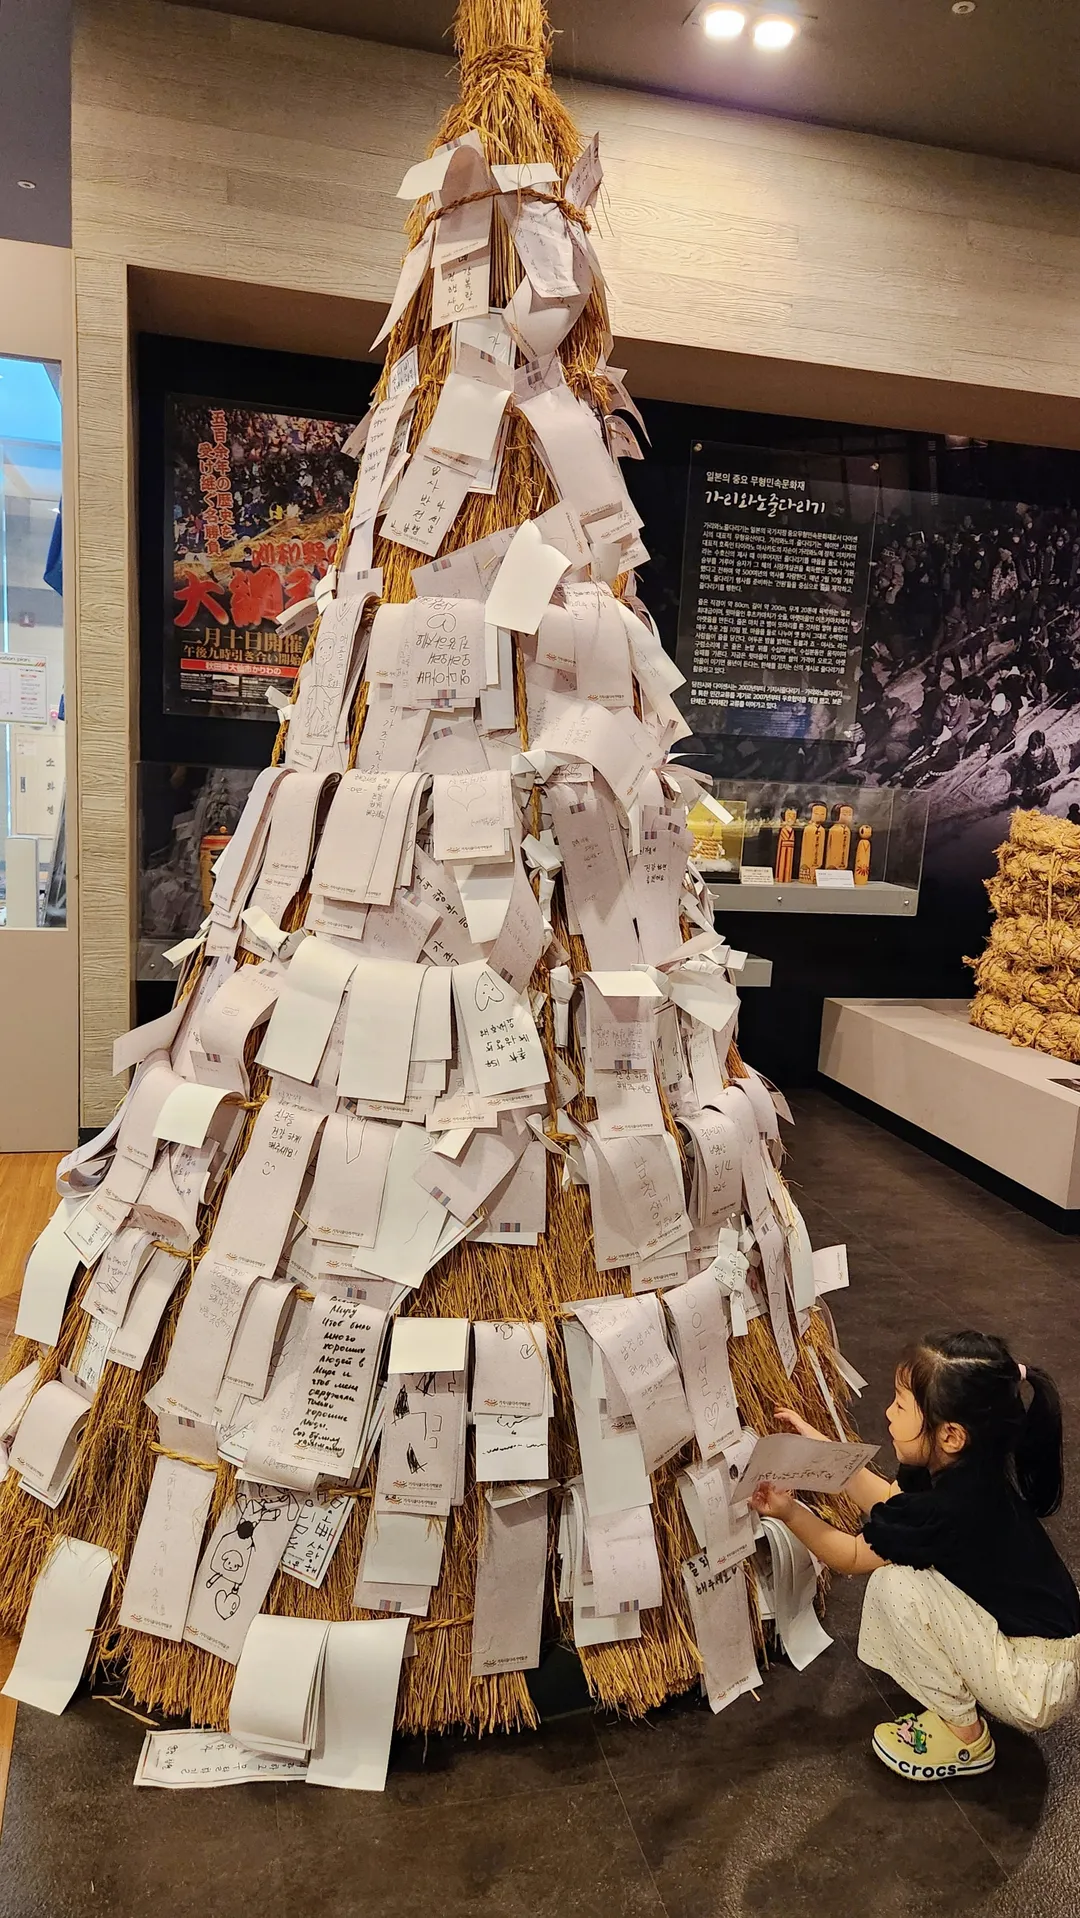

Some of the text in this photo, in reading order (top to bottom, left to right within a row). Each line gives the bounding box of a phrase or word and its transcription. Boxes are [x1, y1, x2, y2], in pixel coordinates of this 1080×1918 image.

[706, 471, 804, 490] 일본의 중요 무형민속문화재
[704, 490, 826, 517] 가리와노줄다리기
[898, 1760, 958, 1778] crocs
